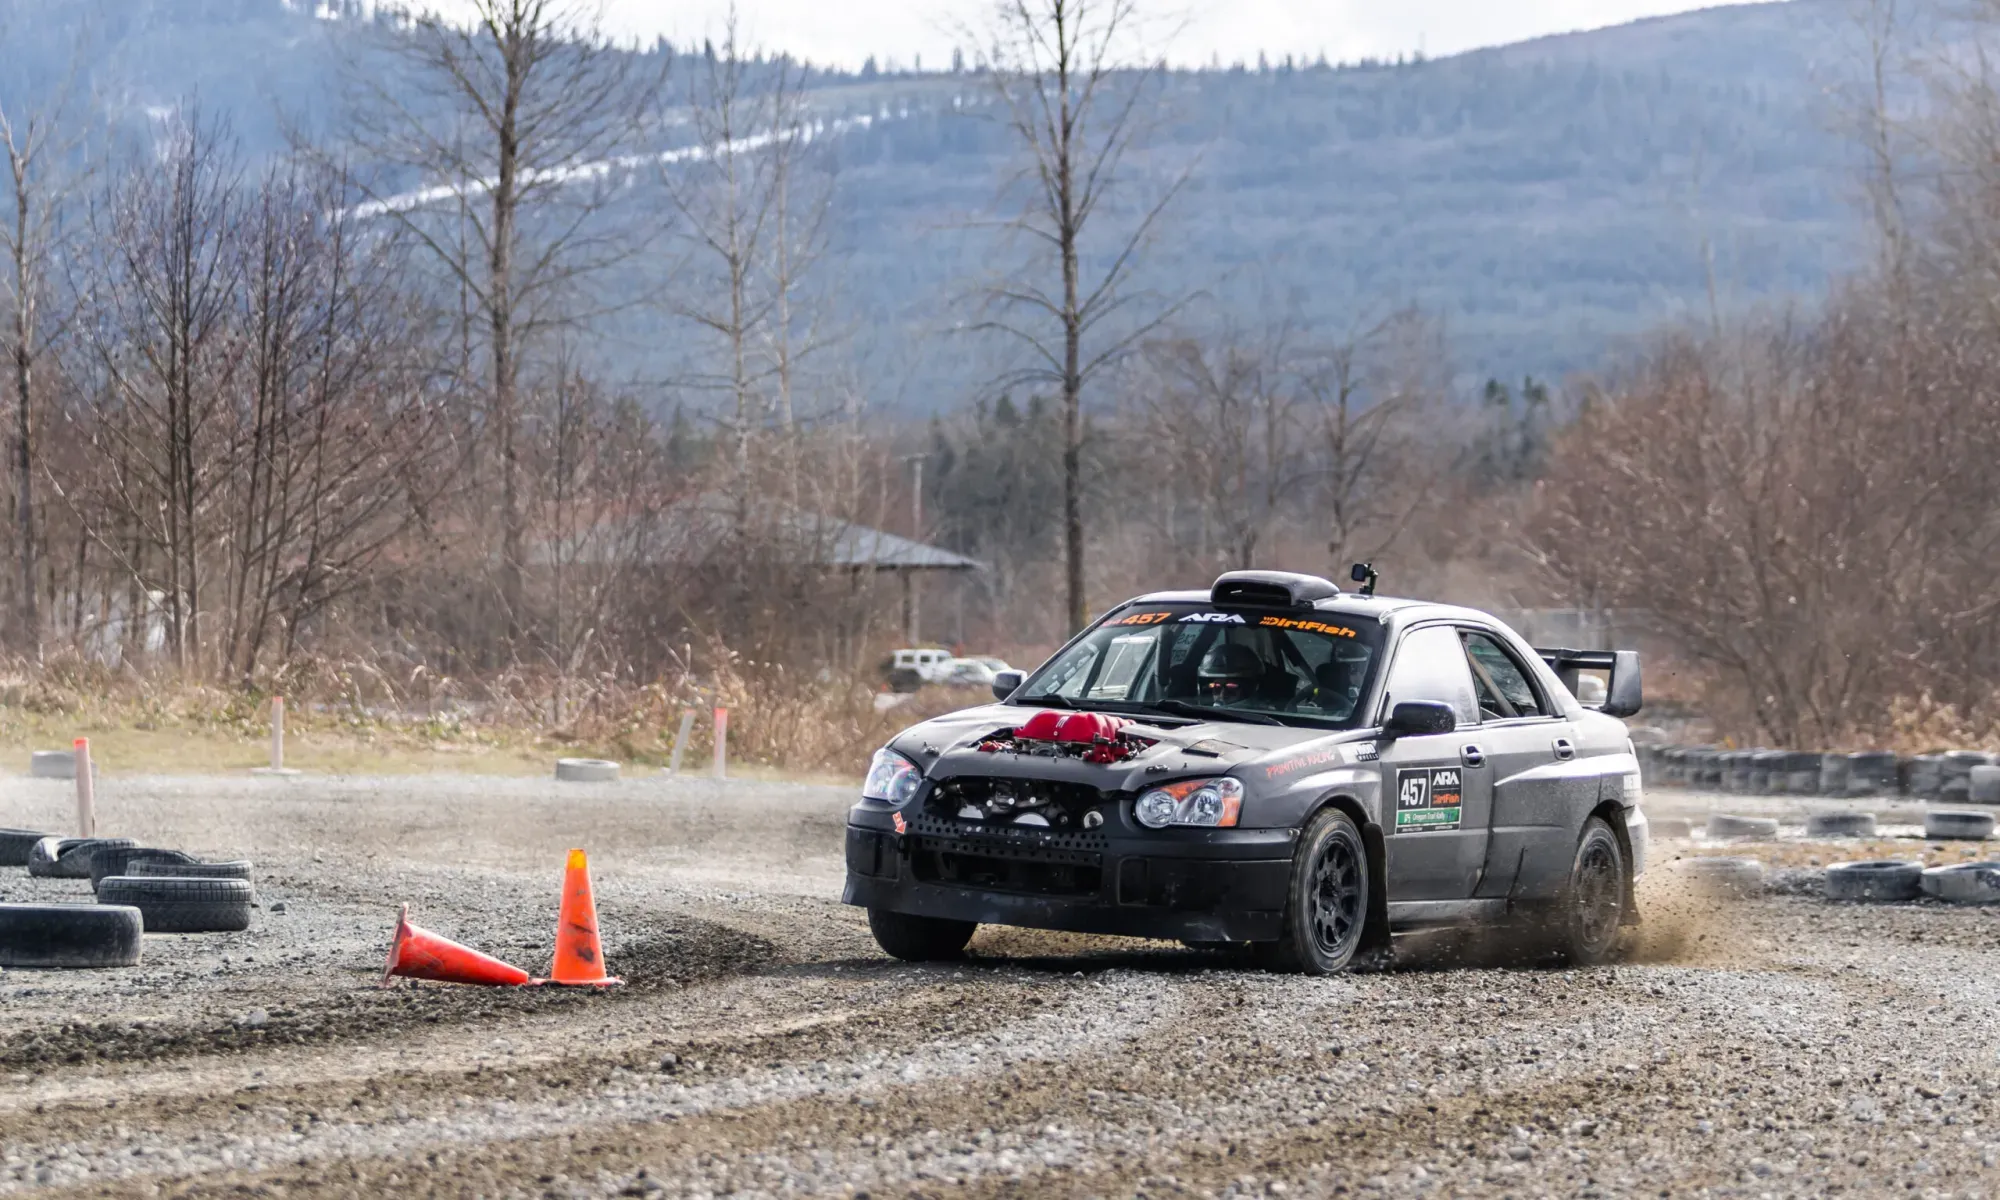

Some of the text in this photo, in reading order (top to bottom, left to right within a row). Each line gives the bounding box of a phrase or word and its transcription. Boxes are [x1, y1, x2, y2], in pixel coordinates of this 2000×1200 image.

[1121, 612, 1172, 625] 457
[1177, 612, 1246, 624] ARA
[1259, 616, 1357, 638] DirtFish
[1432, 771, 1460, 786] ARA
[1400, 777, 1427, 806] 457
